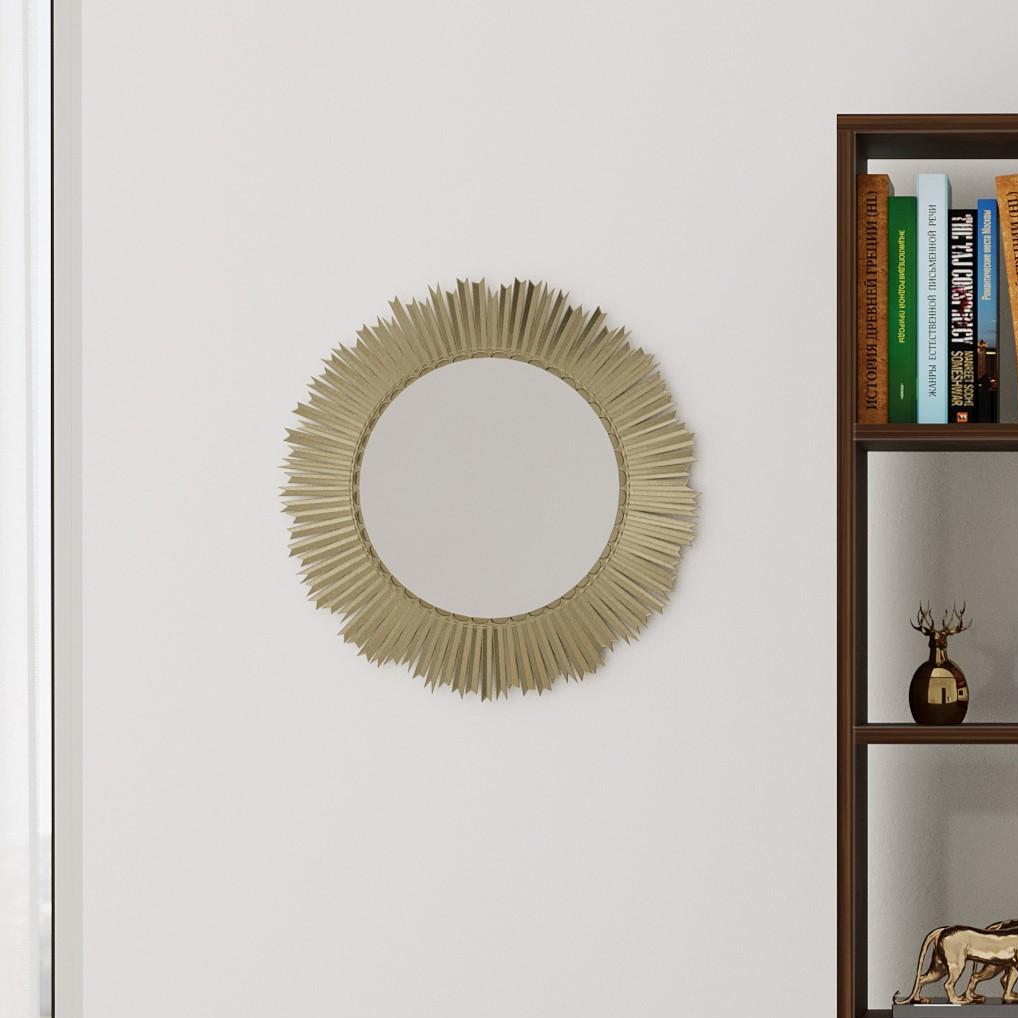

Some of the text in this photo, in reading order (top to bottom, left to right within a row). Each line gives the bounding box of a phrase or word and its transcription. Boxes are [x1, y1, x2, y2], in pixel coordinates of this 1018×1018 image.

[866, 221, 878, 274] ГРЕЦИИ
[952, 214, 973, 240] THE
[952, 243, 973, 266] TAJ
[866, 279, 878, 340] ДРЕВНЕЙ
[898, 280, 906, 308] РОДНОЙ
[927, 204, 936, 397] ЖАНРЫ ЕСТЕСТВЕННОЙ ПИСЬМЕННОЙ РЕЧИ
[866, 344, 877, 409] ИСТОРИЯ
[952, 350, 963, 406] SOMESHWAR
